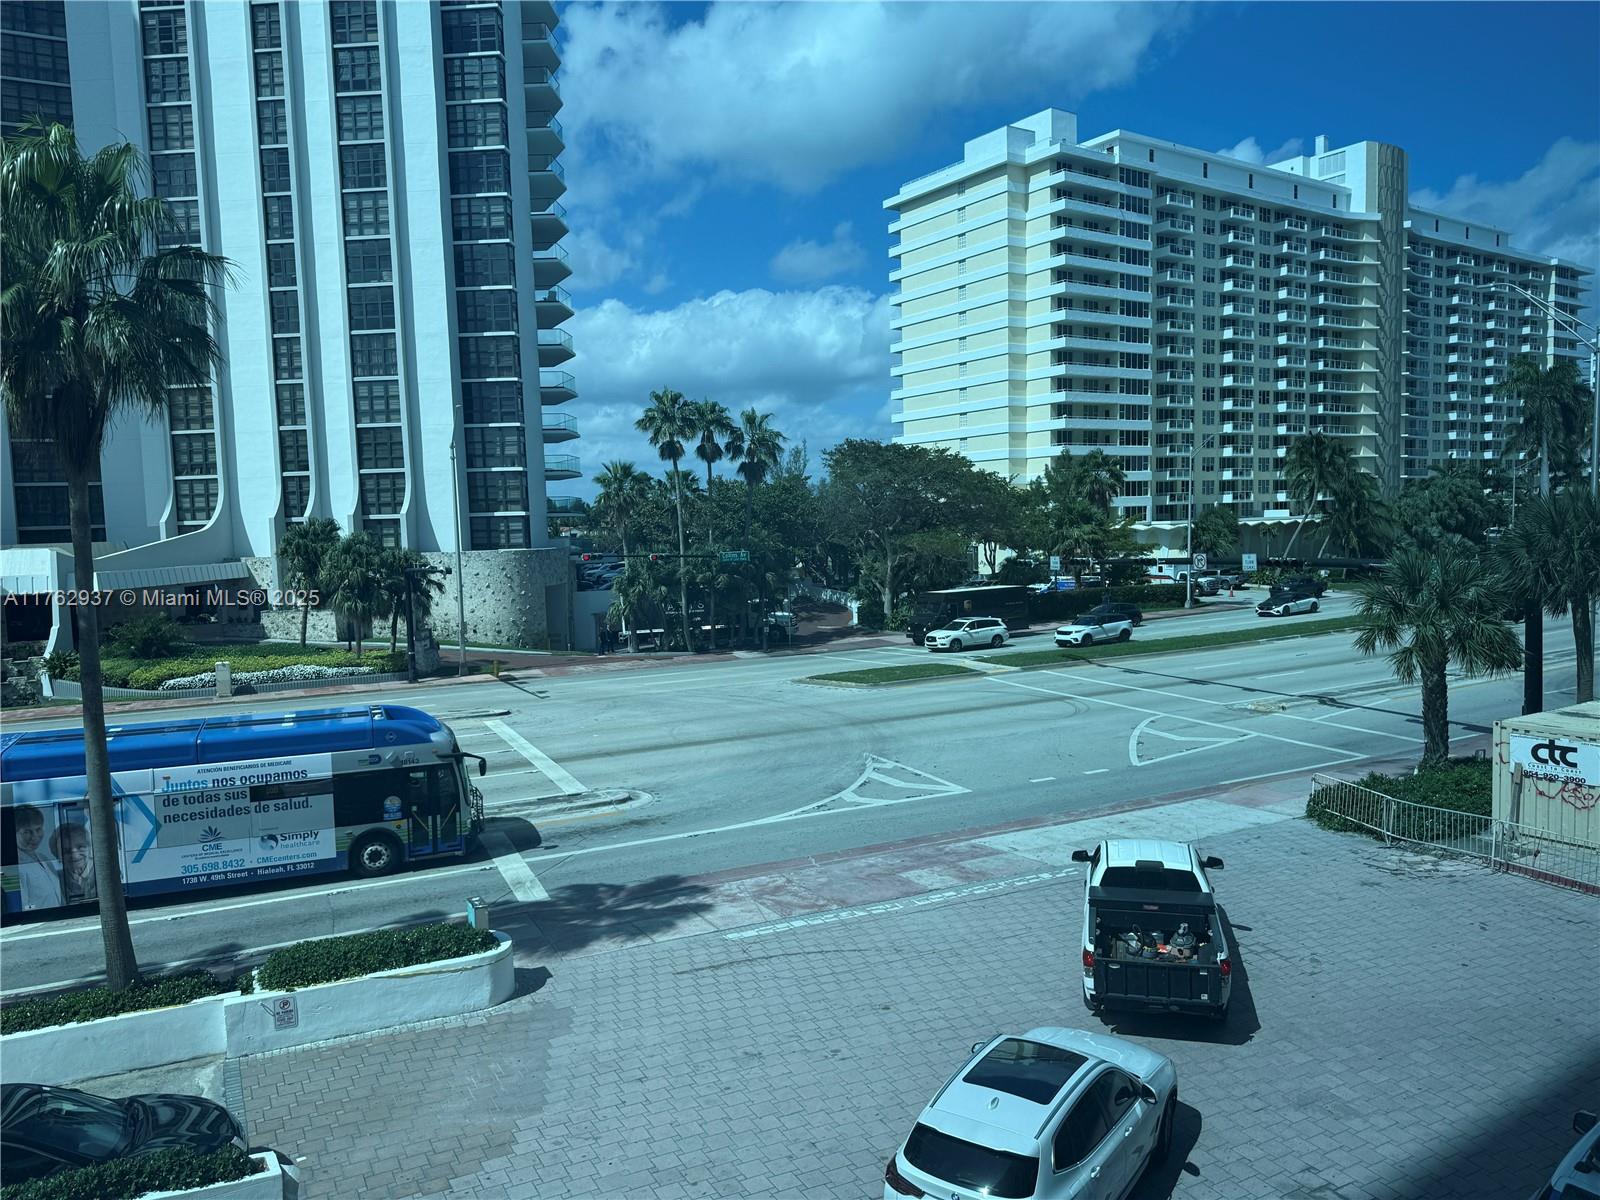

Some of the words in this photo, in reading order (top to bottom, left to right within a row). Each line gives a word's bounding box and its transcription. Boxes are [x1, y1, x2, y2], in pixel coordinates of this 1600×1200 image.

[162, 779, 209, 793] Juntos
[212, 777, 236, 788] nos
[240, 769, 308, 785] ocupamos
[162, 795, 180, 807] de
[183, 791, 221, 806] todas
[224, 790, 248, 801] sus
[163, 805, 251, 824] necesidades
[254, 800, 270, 814] de
[273, 797, 313, 812] salud.
[280, 830, 319, 841] Simply
[201, 843, 223, 852] CME
[280, 840, 320, 849] healthcare
[256, 851, 318, 864] CMEcenters.com
[181, 858, 246, 875] 305.698.8432
[210, 873, 226, 881] 49th
[226, 871, 249, 879] Street
[295, 862, 315, 870] 33012
